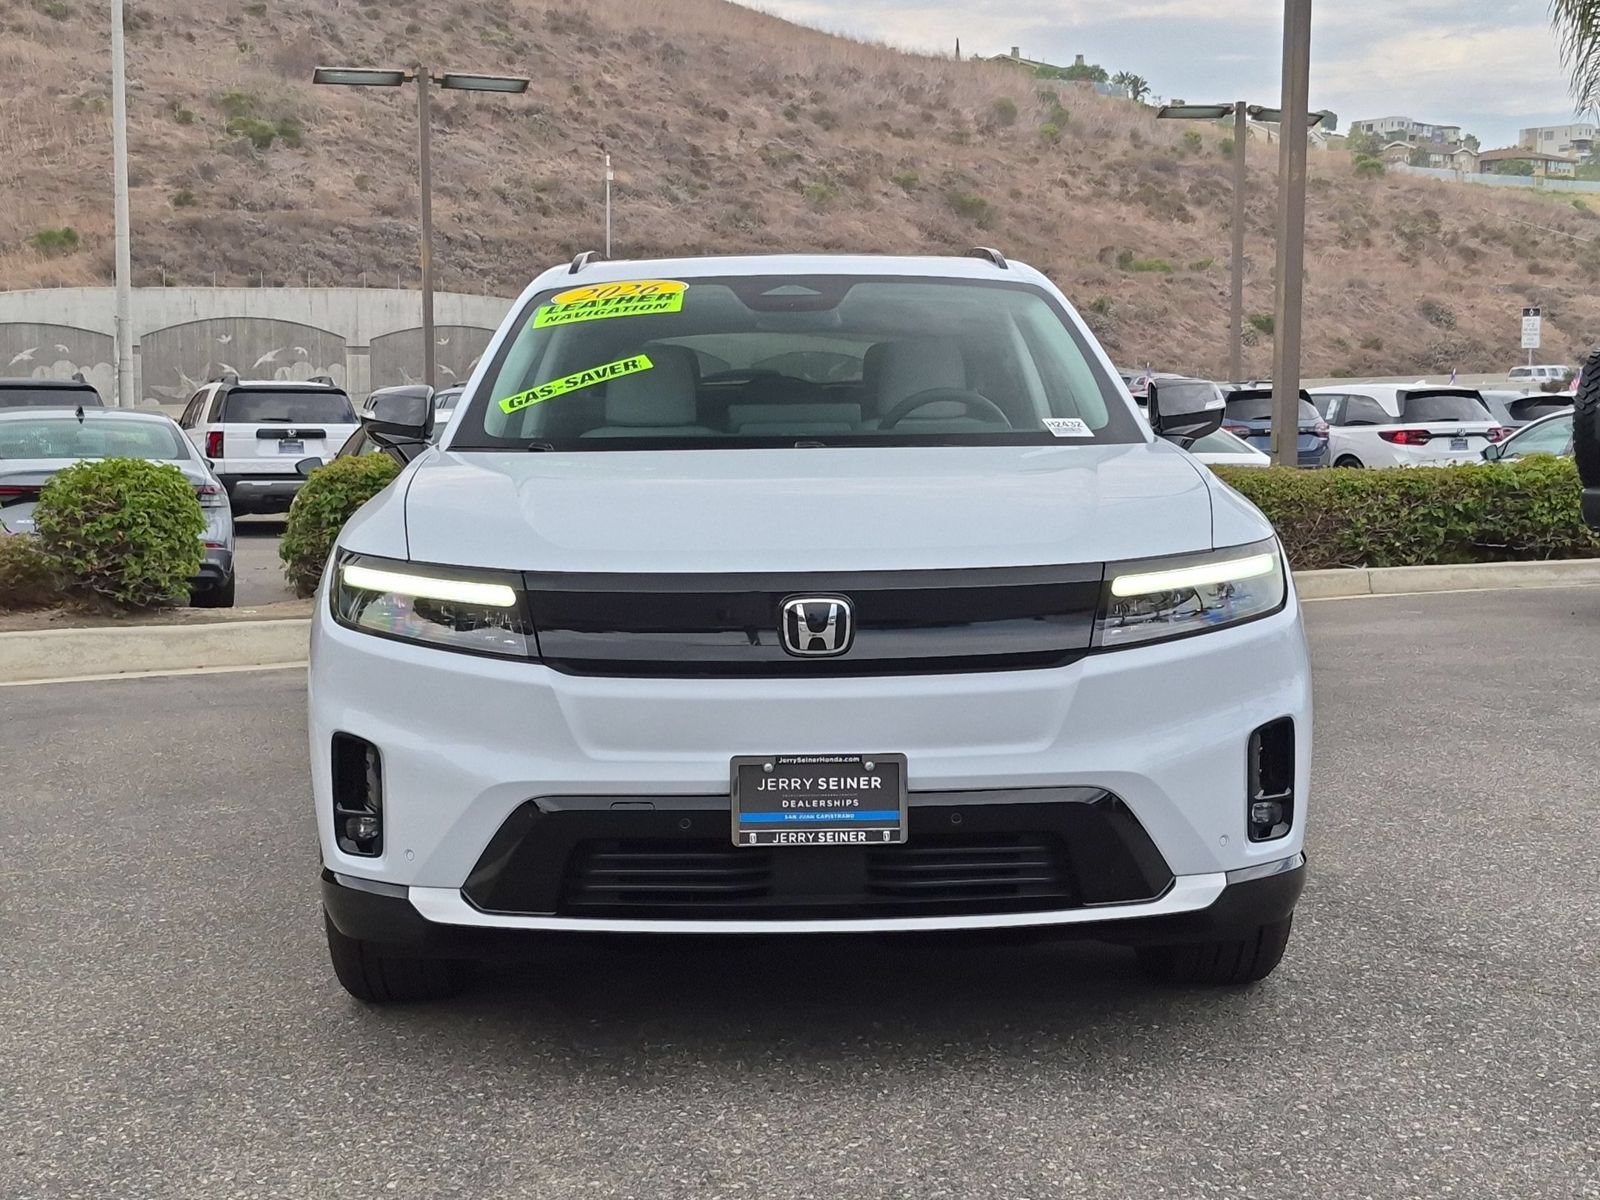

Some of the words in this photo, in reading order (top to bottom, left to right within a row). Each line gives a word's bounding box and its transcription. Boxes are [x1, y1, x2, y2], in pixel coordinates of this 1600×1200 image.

[570, 282, 666, 301] 2026
[545, 292, 677, 315] LEATHER
[544, 302, 669, 324] NAVIGATION
[508, 359, 640, 410] GAS-SAVER
[779, 755, 860, 764] JerrySeinerHonda.com
[757, 778, 814, 791] JERRY
[817, 776, 882, 790] SEINER
[782, 799, 859, 808] DEALERSHIPS
[772, 832, 816, 844] JERRY
[817, 831, 867, 843] SEINER
